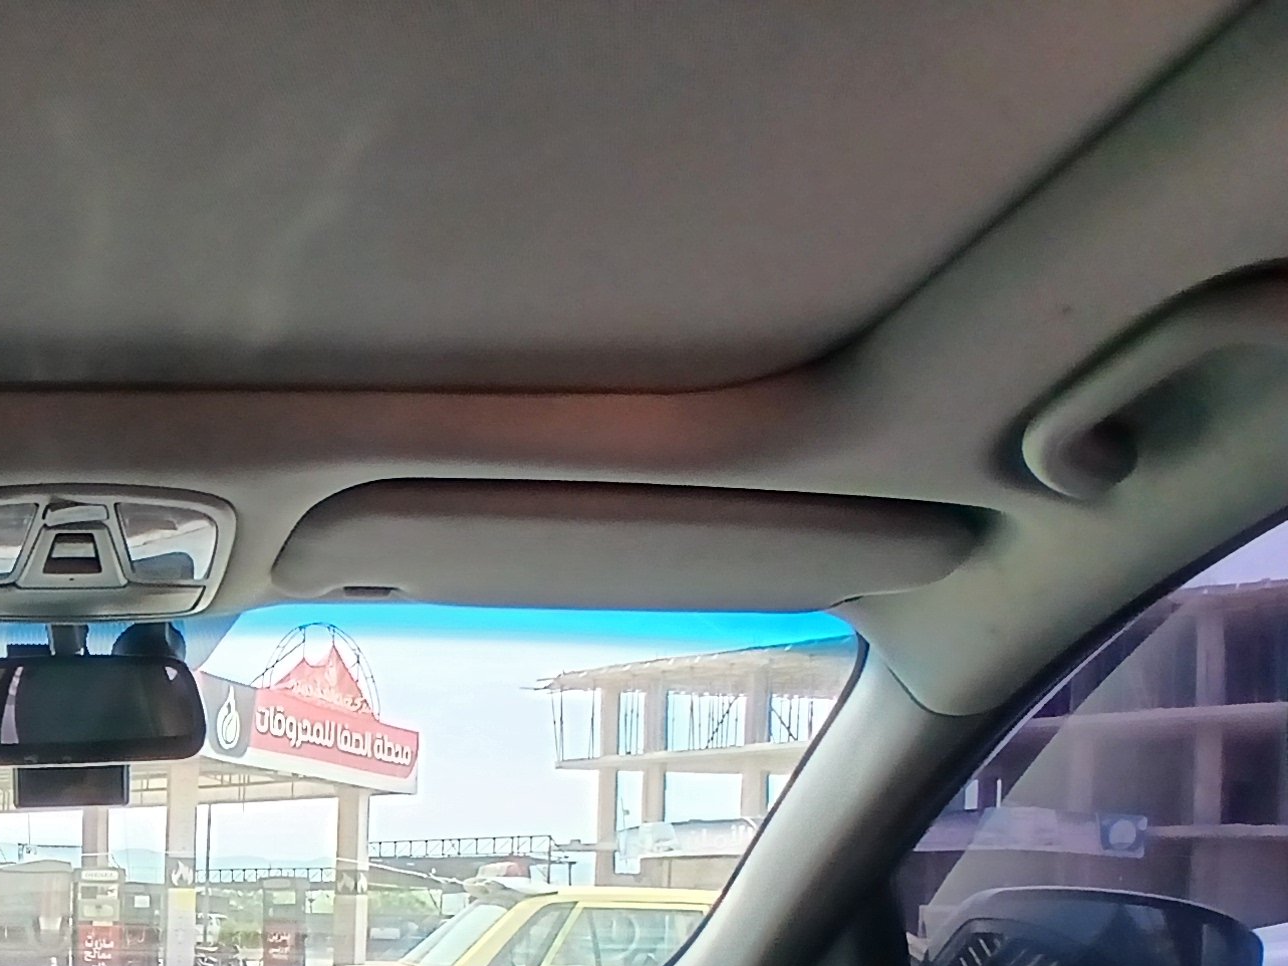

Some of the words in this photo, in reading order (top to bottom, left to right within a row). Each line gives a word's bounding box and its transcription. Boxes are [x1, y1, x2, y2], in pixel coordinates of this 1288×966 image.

[254, 706, 336, 749] للمحروقات
[337, 723, 372, 758] الصفا
[373, 733, 413, 767] محطة
